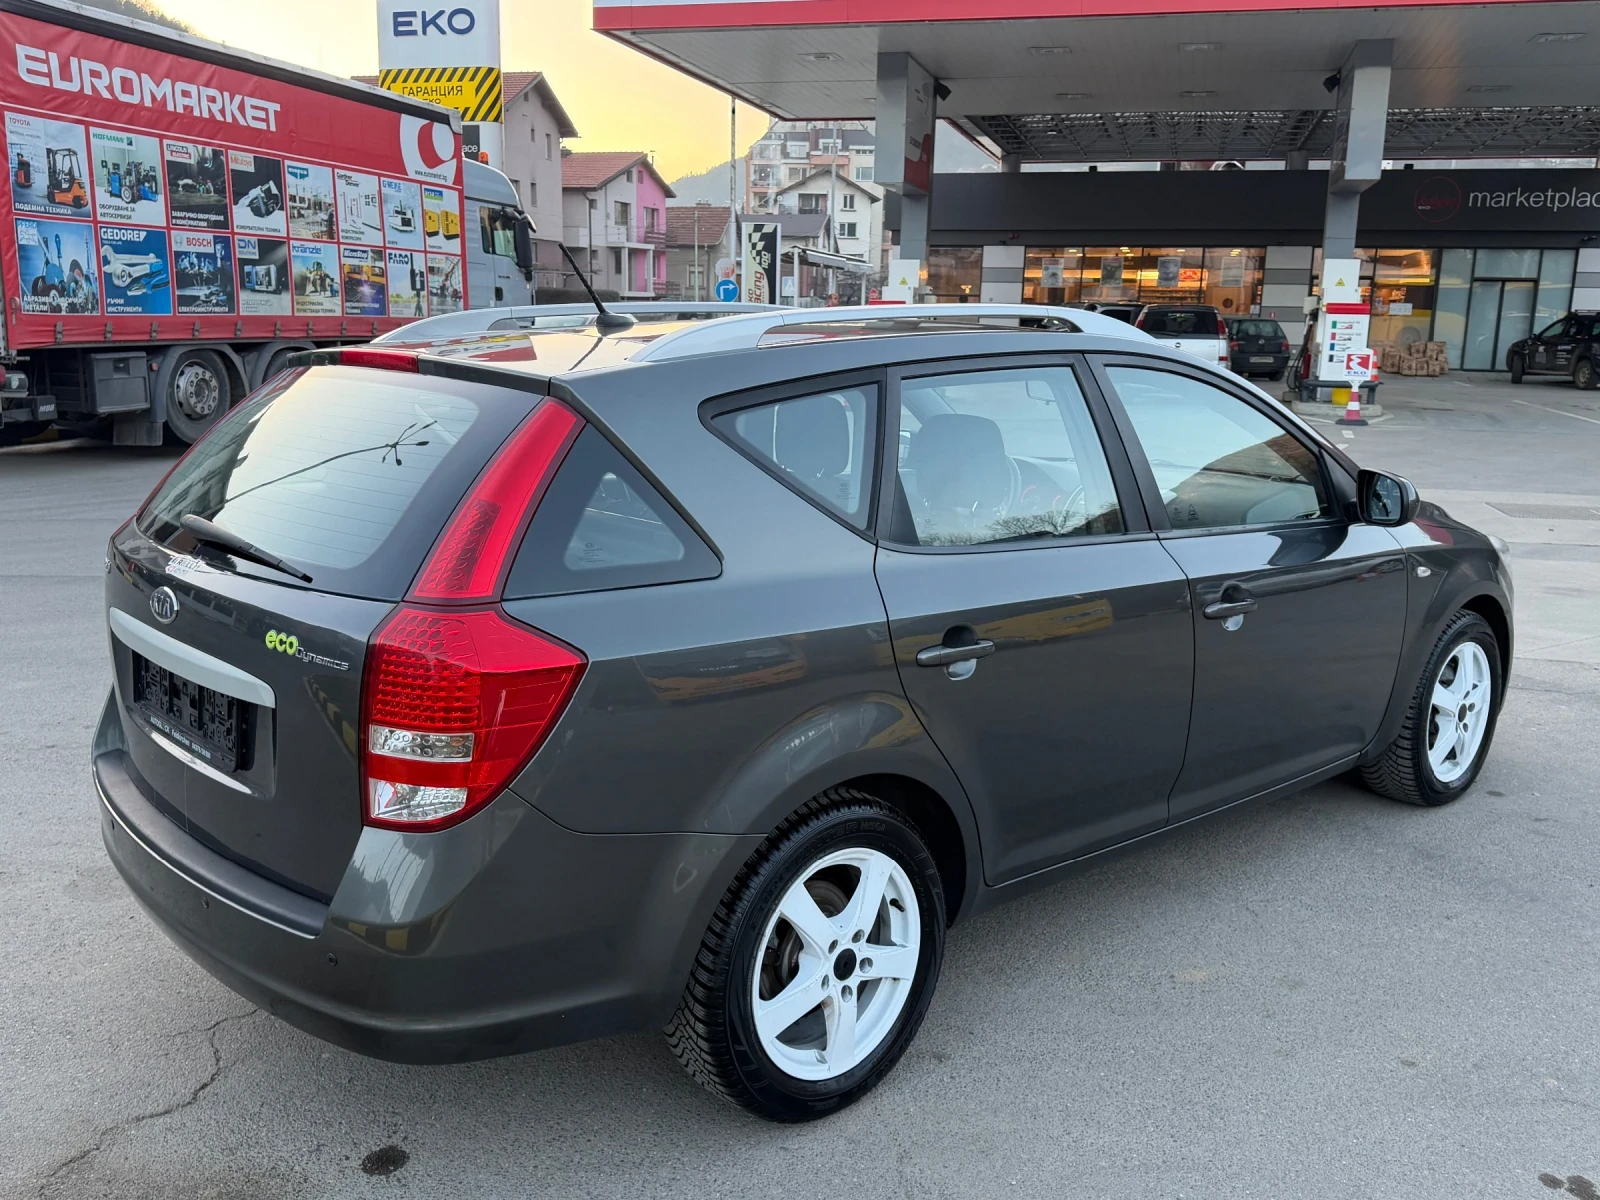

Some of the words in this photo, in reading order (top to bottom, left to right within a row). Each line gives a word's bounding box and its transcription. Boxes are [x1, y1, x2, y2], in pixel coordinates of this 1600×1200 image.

[392, 8, 476, 37] EKO
[15, 43, 281, 132] EUROMARKET
[402, 86, 463, 98] ГАРАНЦИЯ
[9, 117, 31, 127] TOYOTA
[92, 132, 125, 144] HOFMANN
[15, 202, 45, 212] ПОДЕМНА
[46, 206, 72, 215] ТЕХНИКА
[99, 203, 129, 213] ОБОРУДВАНЕ
[100, 211, 133, 220] АВТОСЕРВИЗИ
[171, 211, 198, 219] ЗАВАРЪЧНО
[198, 213, 225, 222] ОБОРУДВАНЕ
[101, 228, 141, 242] GEDORE
[186, 237, 212, 247] BOSCH
[238, 239, 257, 250] DN
[388, 252, 409, 265] FARO
[761, 251, 769, 269] 100
[24, 303, 48, 312] МЕТАЛИ
[153, 593, 171, 618] KIA
[265, 630, 299, 656] eco
